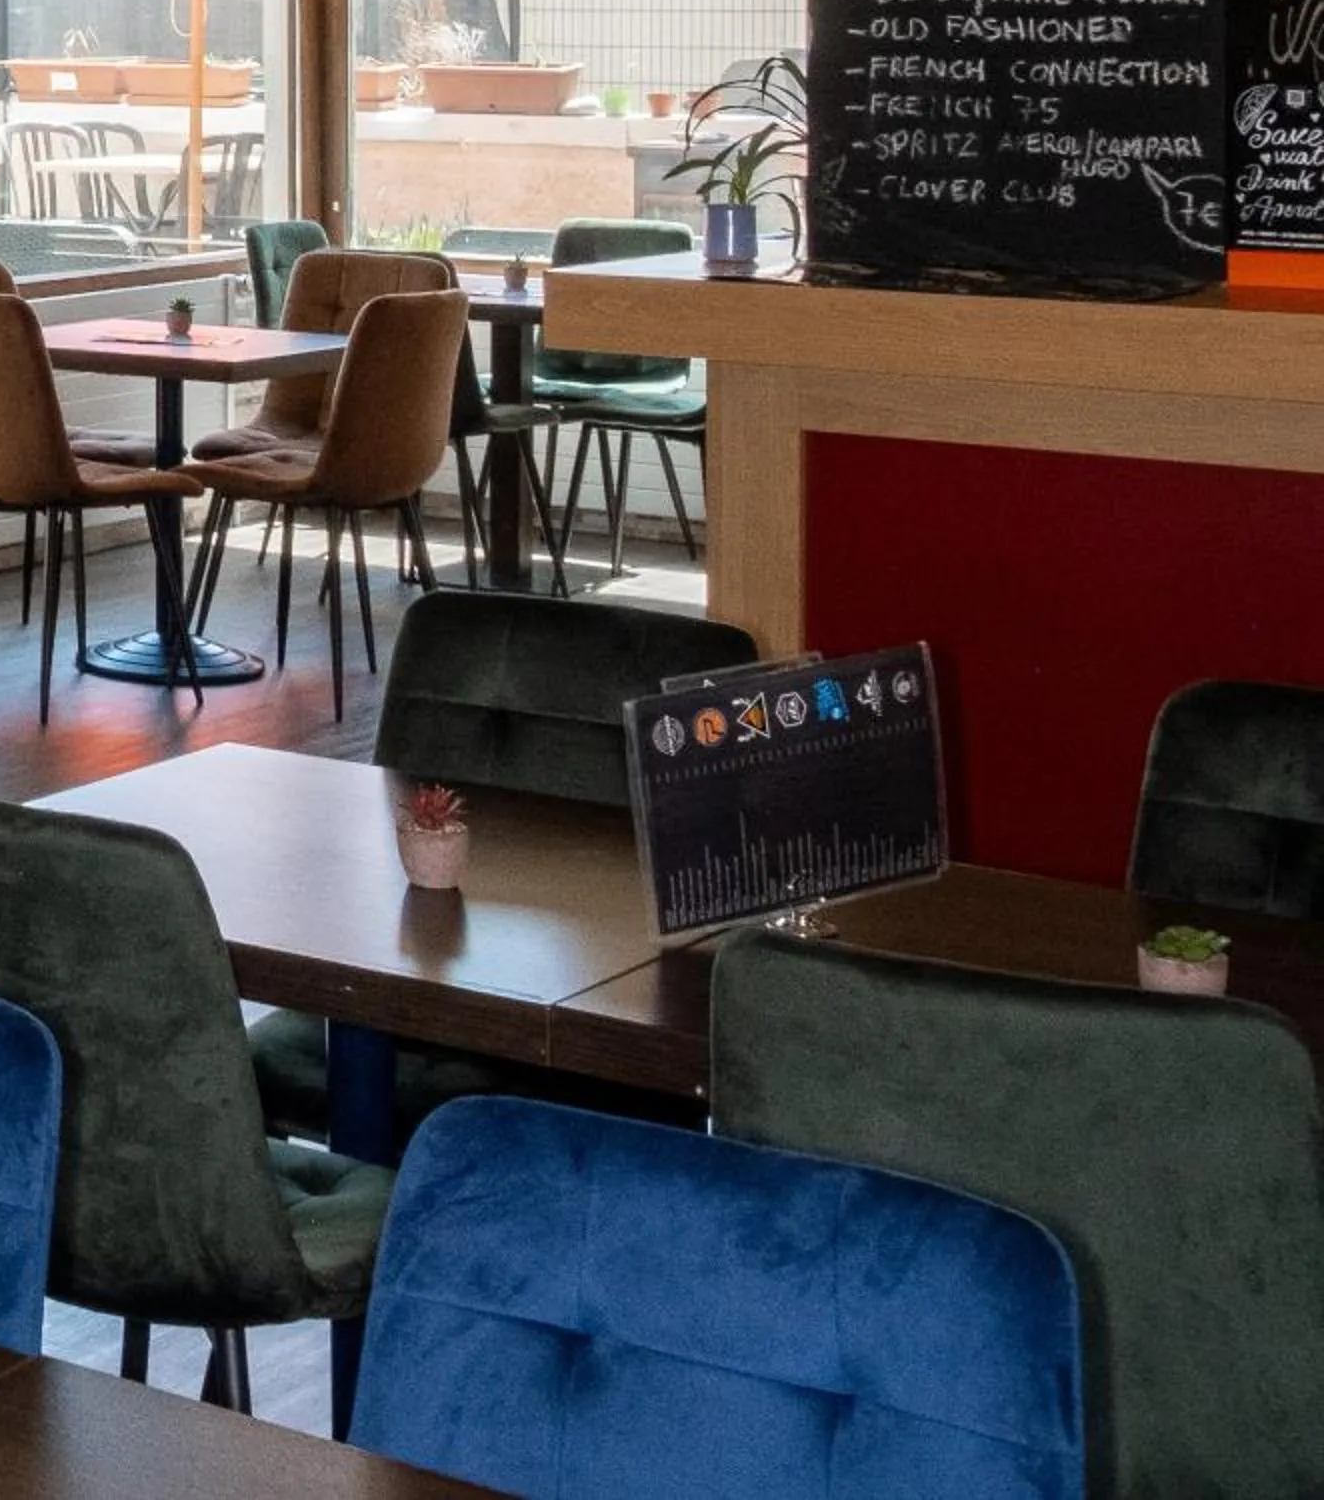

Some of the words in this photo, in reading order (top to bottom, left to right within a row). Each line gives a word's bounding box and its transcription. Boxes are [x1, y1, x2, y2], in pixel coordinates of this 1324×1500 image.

[869, 17, 930, 42] OLD
[869, 55, 986, 82] FRENCH
[1010, 56, 1210, 88] CONNECTION
[1011, 94, 1060, 124] 75
[875, 128, 979, 161] SPRITZ
[1060, 159, 1130, 182] HUGO
